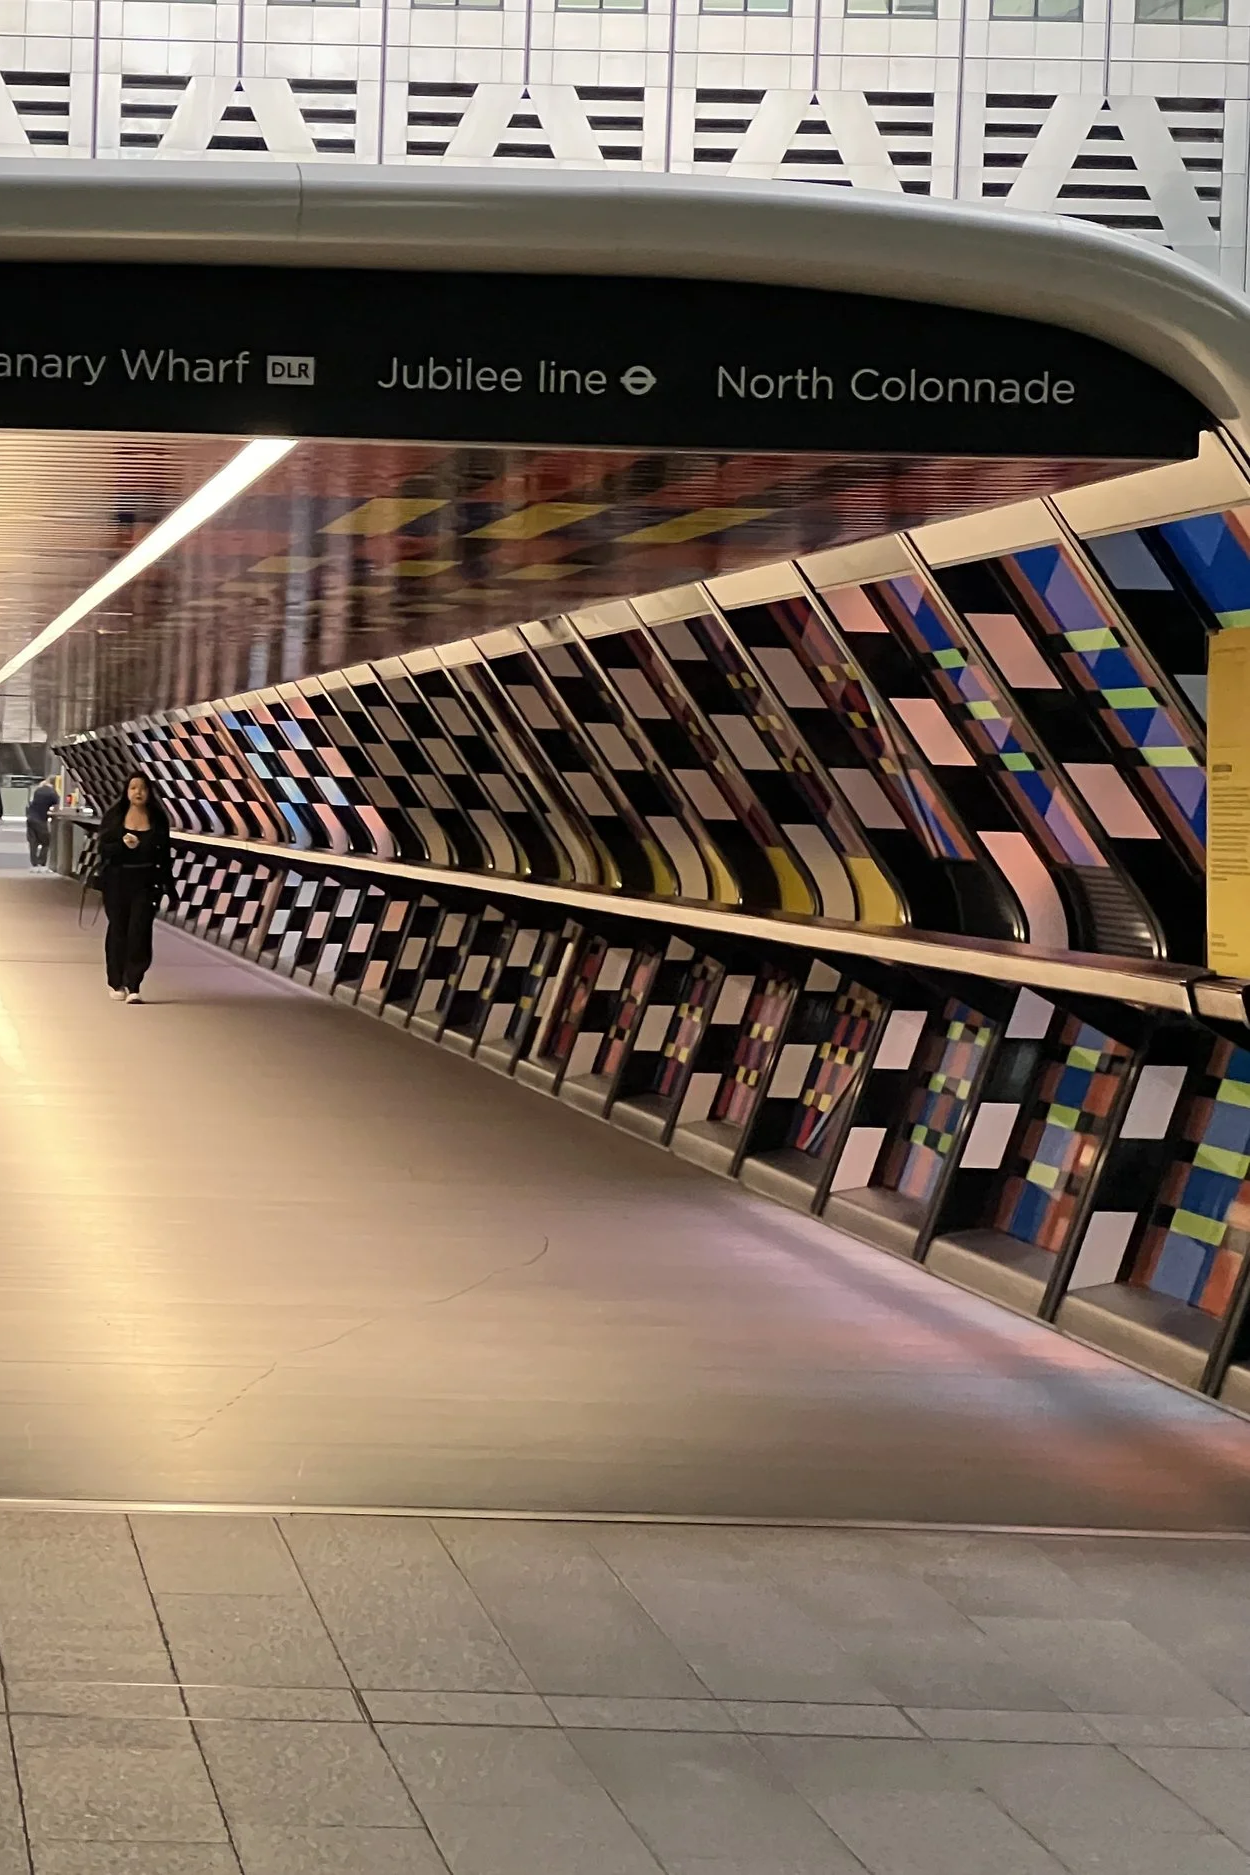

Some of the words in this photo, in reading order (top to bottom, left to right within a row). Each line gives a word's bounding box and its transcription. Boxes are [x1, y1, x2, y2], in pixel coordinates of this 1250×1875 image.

[120, 348, 250, 384] Wharf
[271, 361, 310, 379] DLR
[376, 356, 523, 393] Jubilee
[538, 360, 607, 395] line
[716, 365, 833, 400] North
[849, 368, 1075, 404] Colonnade
